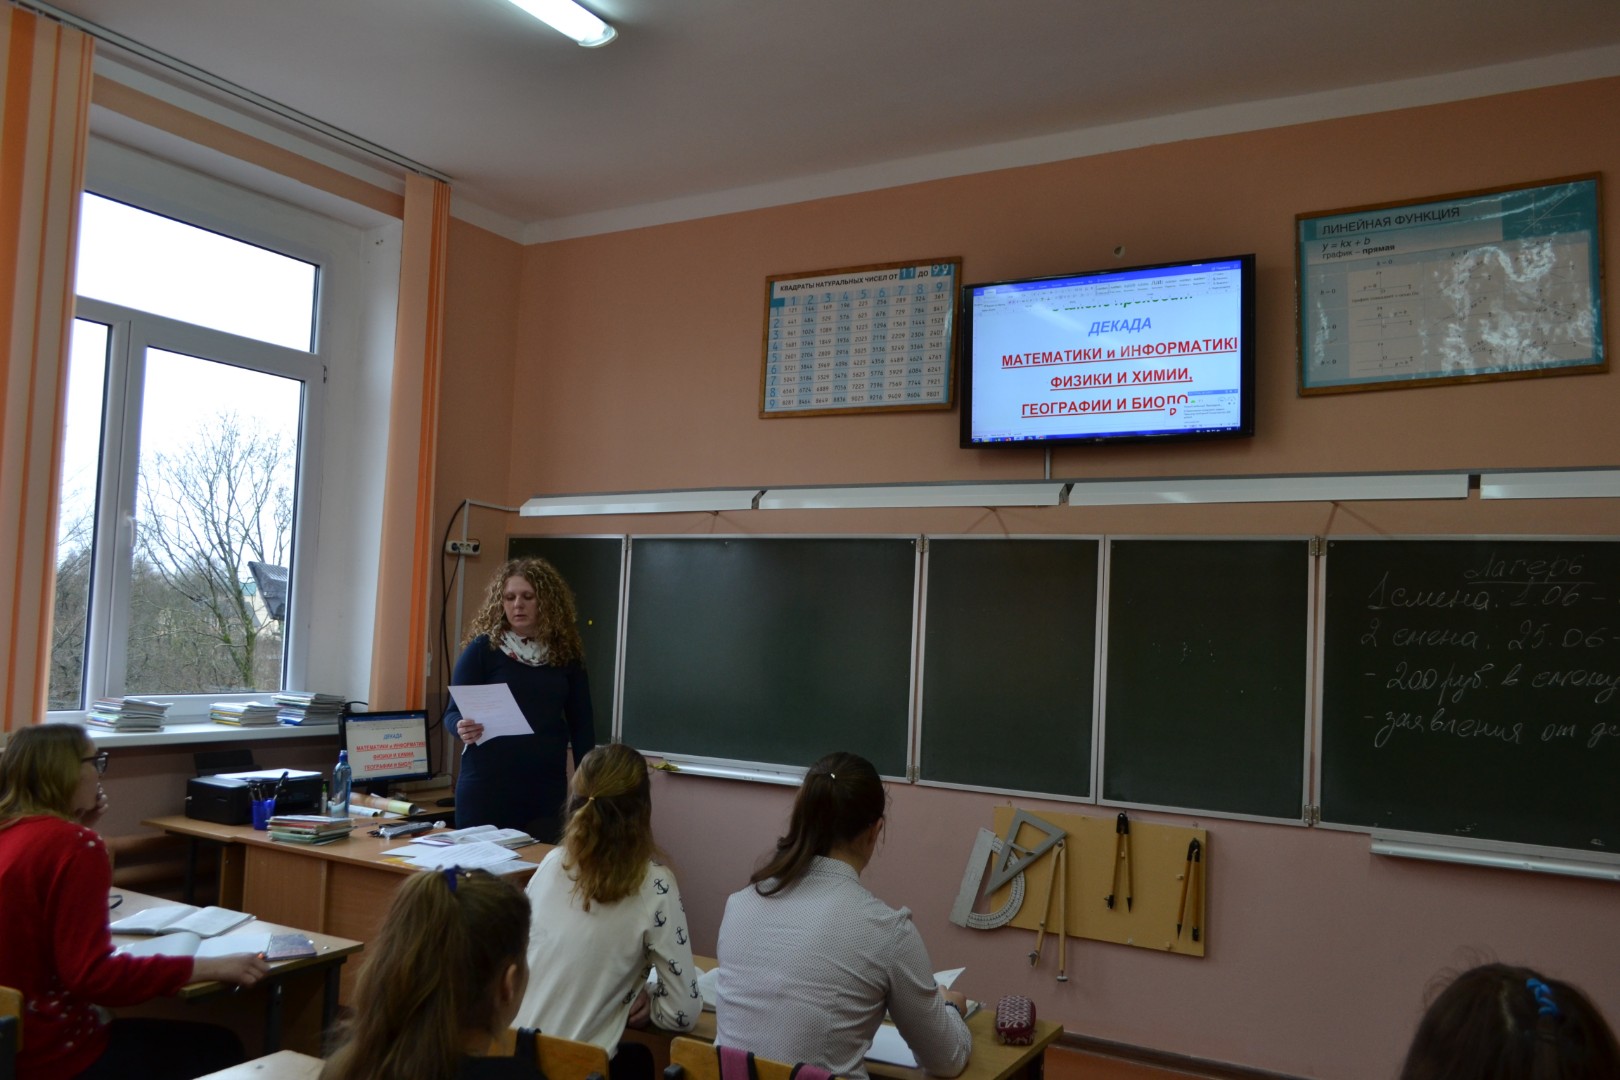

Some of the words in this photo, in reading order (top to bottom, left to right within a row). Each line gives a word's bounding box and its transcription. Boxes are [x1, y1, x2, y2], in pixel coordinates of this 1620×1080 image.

[1322, 216, 1392, 235] ЛИНЕЙНАЯ
[1395, 207, 1460, 225] ФУНКЦИЯ
[1322, 251, 1351, 259] график
[1362, 243, 1395, 255] прямая
[1340, 239, 1352, 248] kx
[780, 282, 815, 292] КВАДРАТЫ
[815, 278, 864, 288] НАТУРАЛЬНЫХ
[865, 275, 887, 283] ЧИСЕЛ
[901, 267, 915, 278] 11
[918, 270, 929, 278] ДО
[933, 264, 949, 275] 99
[791, 297, 796, 306] 1
[807, 295, 814, 304] 2
[825, 293, 831, 302] 3
[843, 291, 848, 301] 4
[860, 289, 867, 299] 5
[879, 287, 886, 298] 6
[898, 285, 904, 295] 7
[917, 284, 924, 294] 8
[936, 282, 943, 292] 9
[775, 307, 780, 316] 1
[773, 319, 779, 328] 2
[1088, 317, 1152, 336] ДЕКАДА
[772, 330, 779, 339] 3
[772, 342, 778, 351] 4
[772, 353, 778, 363] 5
[1001, 347, 1102, 367] МАТЕМАТИКИ
[1107, 348, 1116, 359] и
[771, 365, 777, 374] 6
[771, 377, 777, 385] 7
[1050, 371, 1112, 389] ФИЗИКИ
[1117, 372, 1127, 384] И
[770, 388, 776, 397] 8
[770, 400, 775, 408] 9
[1021, 398, 1112, 416] ГЕОГРАФИИ
[1117, 399, 1127, 411] И
[1368, 571, 1389, 609] 1
[1360, 617, 1380, 647] 2
[1387, 661, 1437, 690] 200
